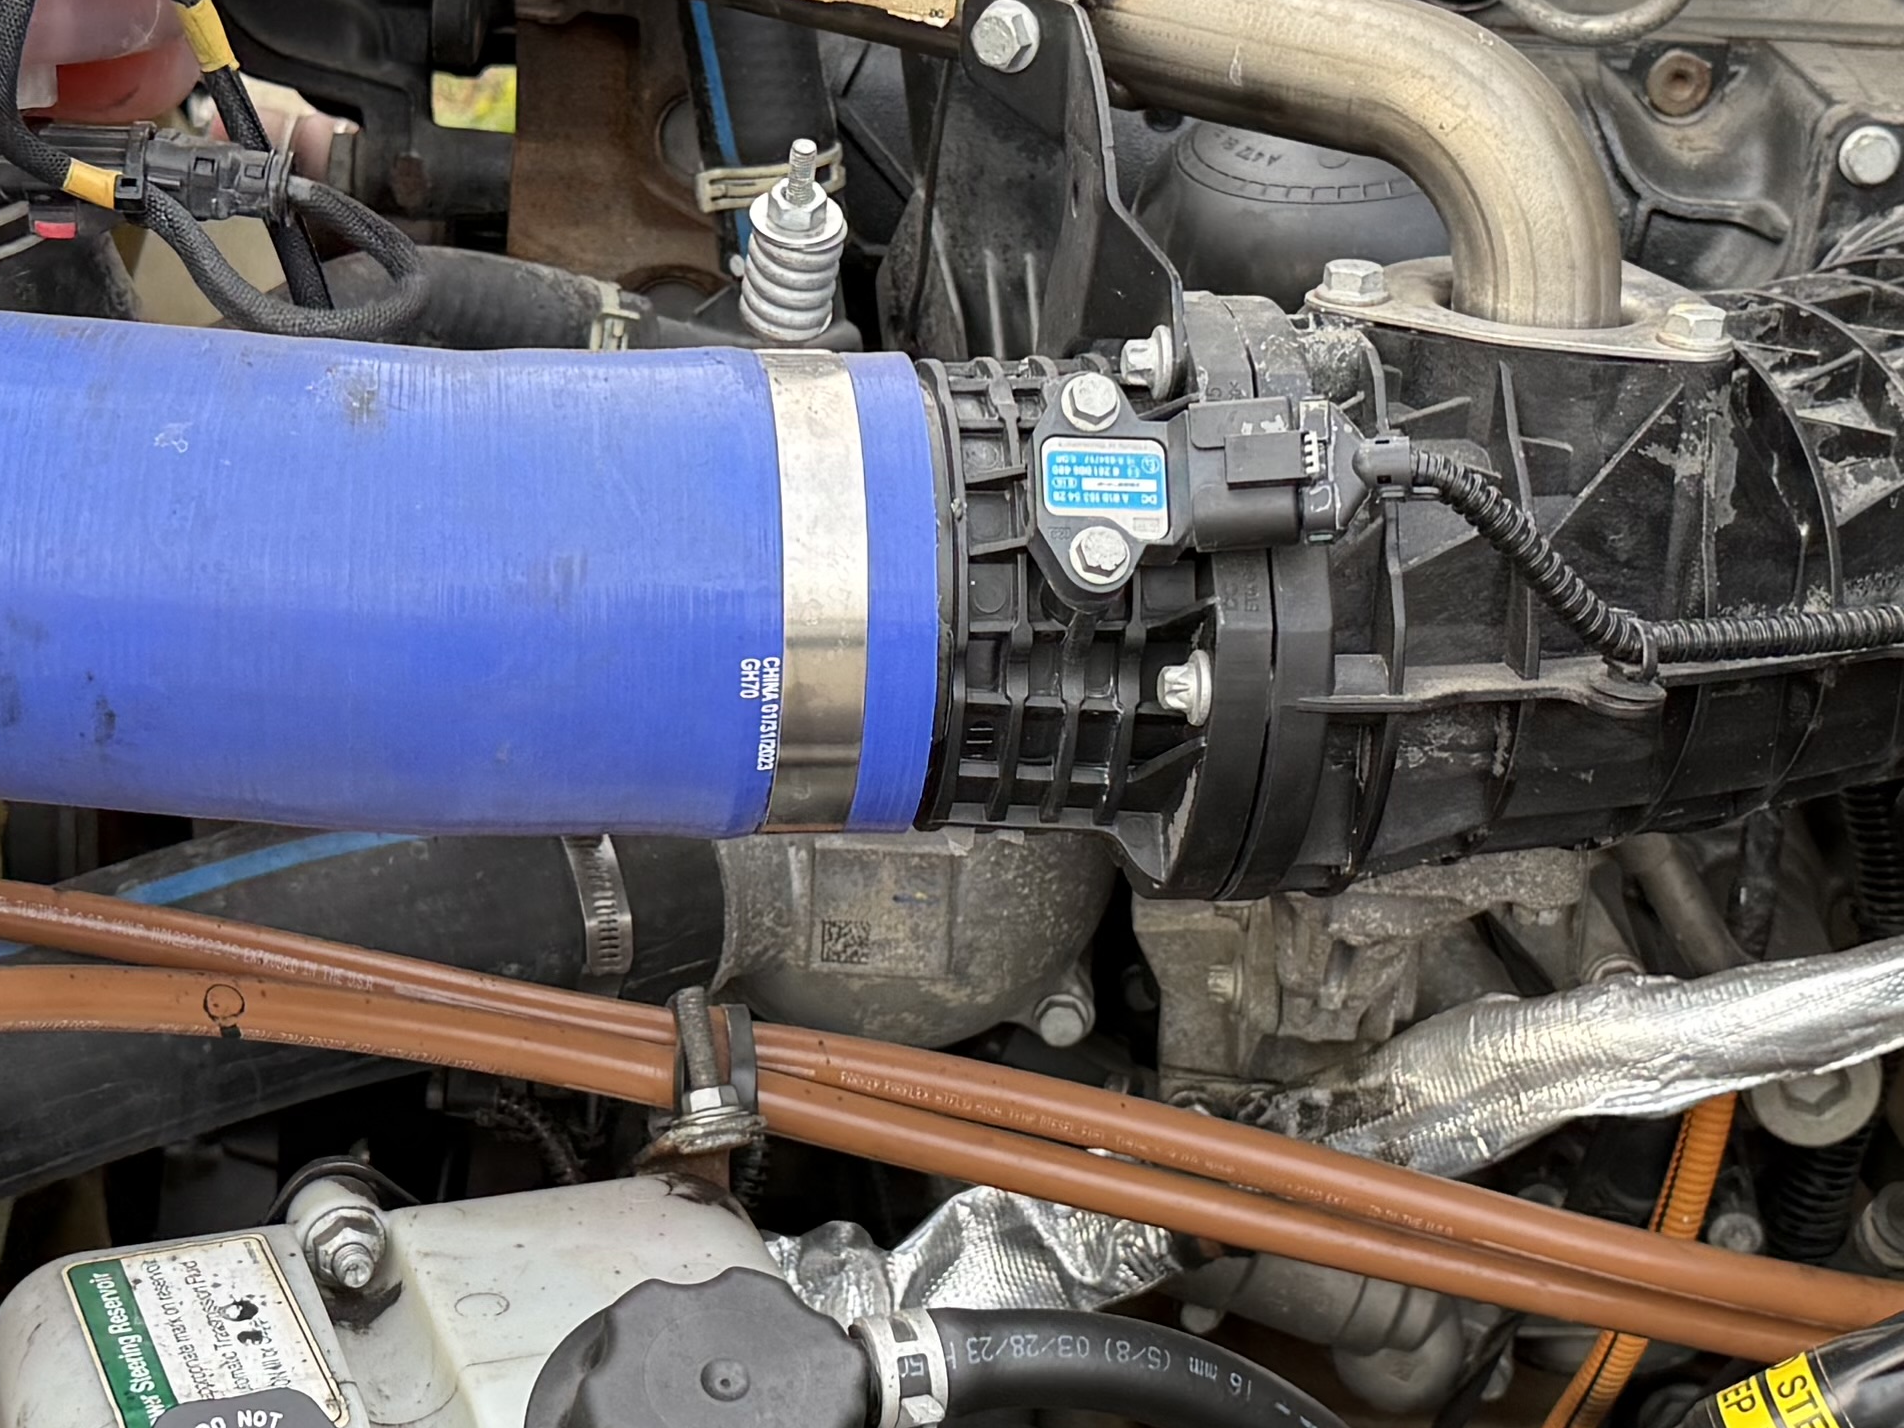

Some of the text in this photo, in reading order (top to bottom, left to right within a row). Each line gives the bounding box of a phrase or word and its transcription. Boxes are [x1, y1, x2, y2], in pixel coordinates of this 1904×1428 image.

[1141, 494, 1158, 505] DC
[740, 658, 761, 699] GH70
[757, 657, 780, 771] CHINA 01/31/2023
[162, 1301, 179, 1316] on
[88, 1271, 156, 1394] Steering Reservoir
[965, 1333, 1090, 1364] 03/28/23
[1103, 1337, 1172, 1372] (5/8)
[1189, 1355, 1219, 1381] mm
[1229, 1372, 1252, 1402] 16
